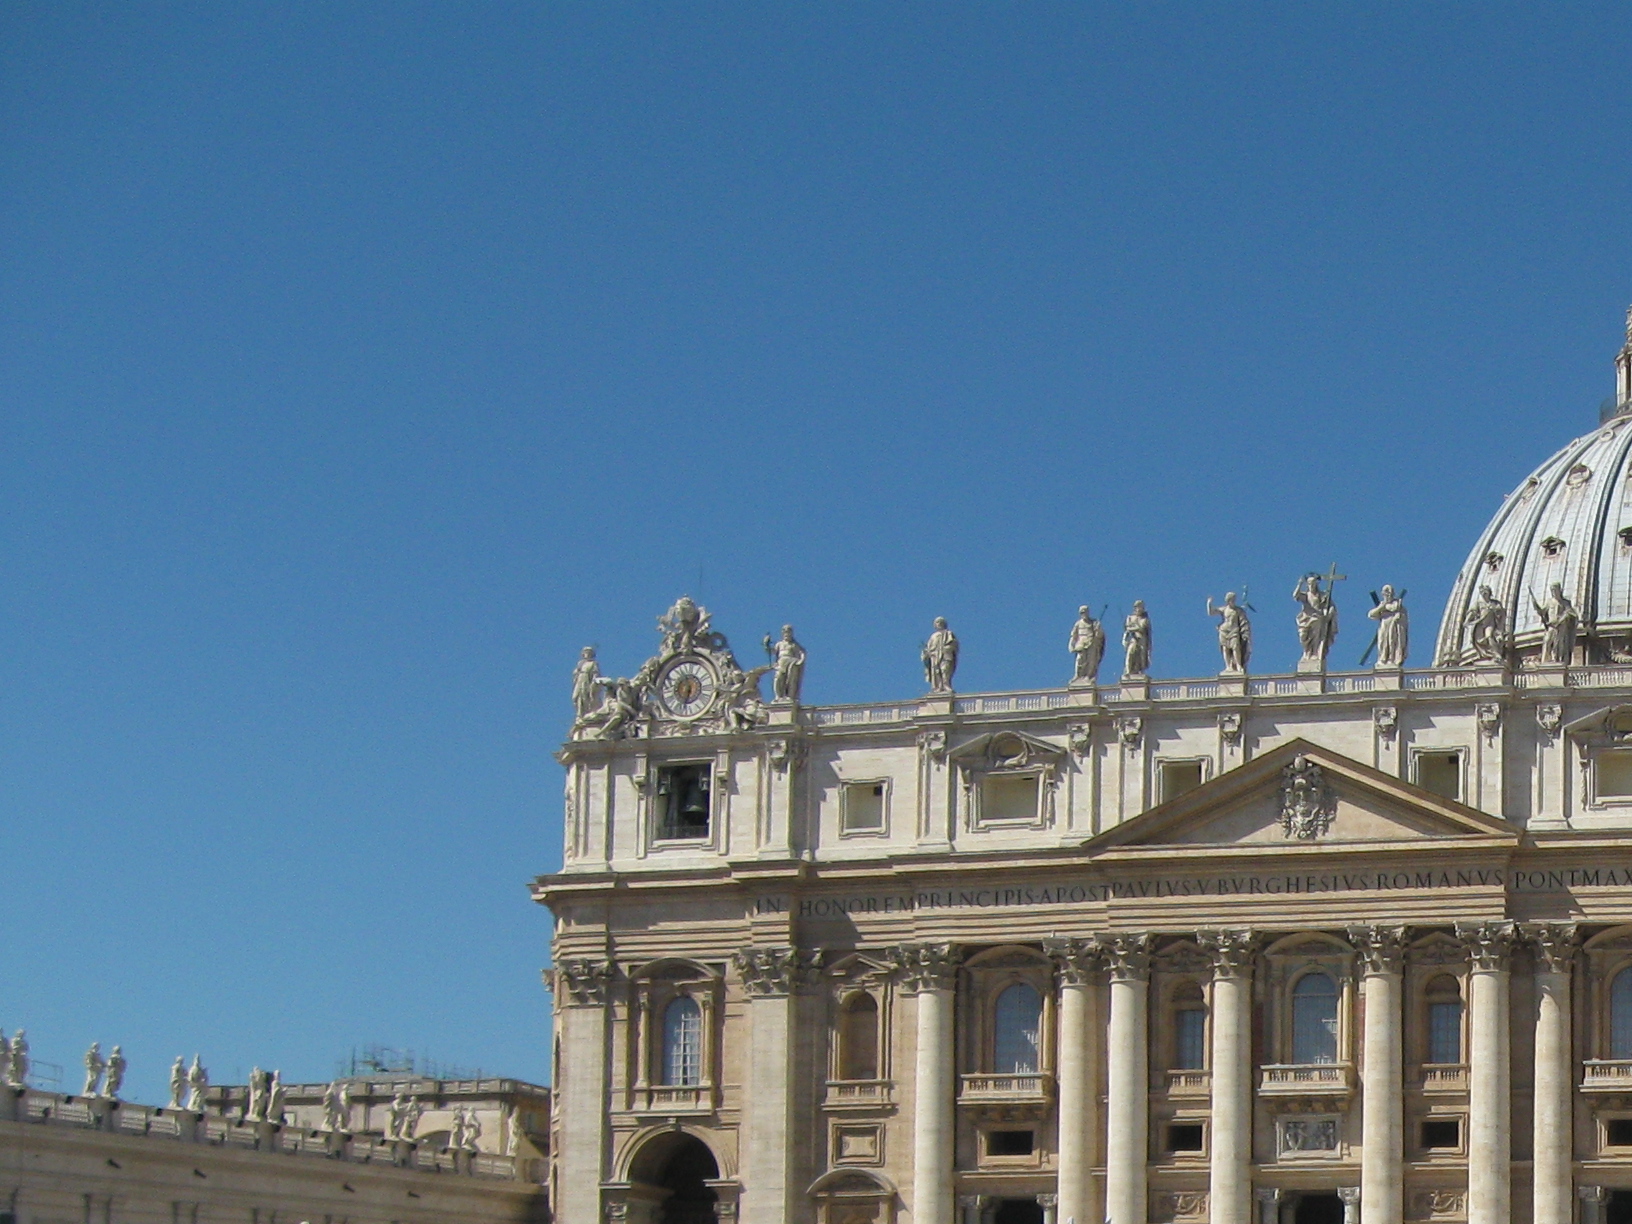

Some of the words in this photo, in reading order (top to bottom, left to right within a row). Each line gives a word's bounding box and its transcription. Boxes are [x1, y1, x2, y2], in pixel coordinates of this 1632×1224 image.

[800, 896, 914, 917] HONOREM
[918, 888, 1034, 910] PRINCIPIS
[1377, 869, 1505, 890] ROMANVS
